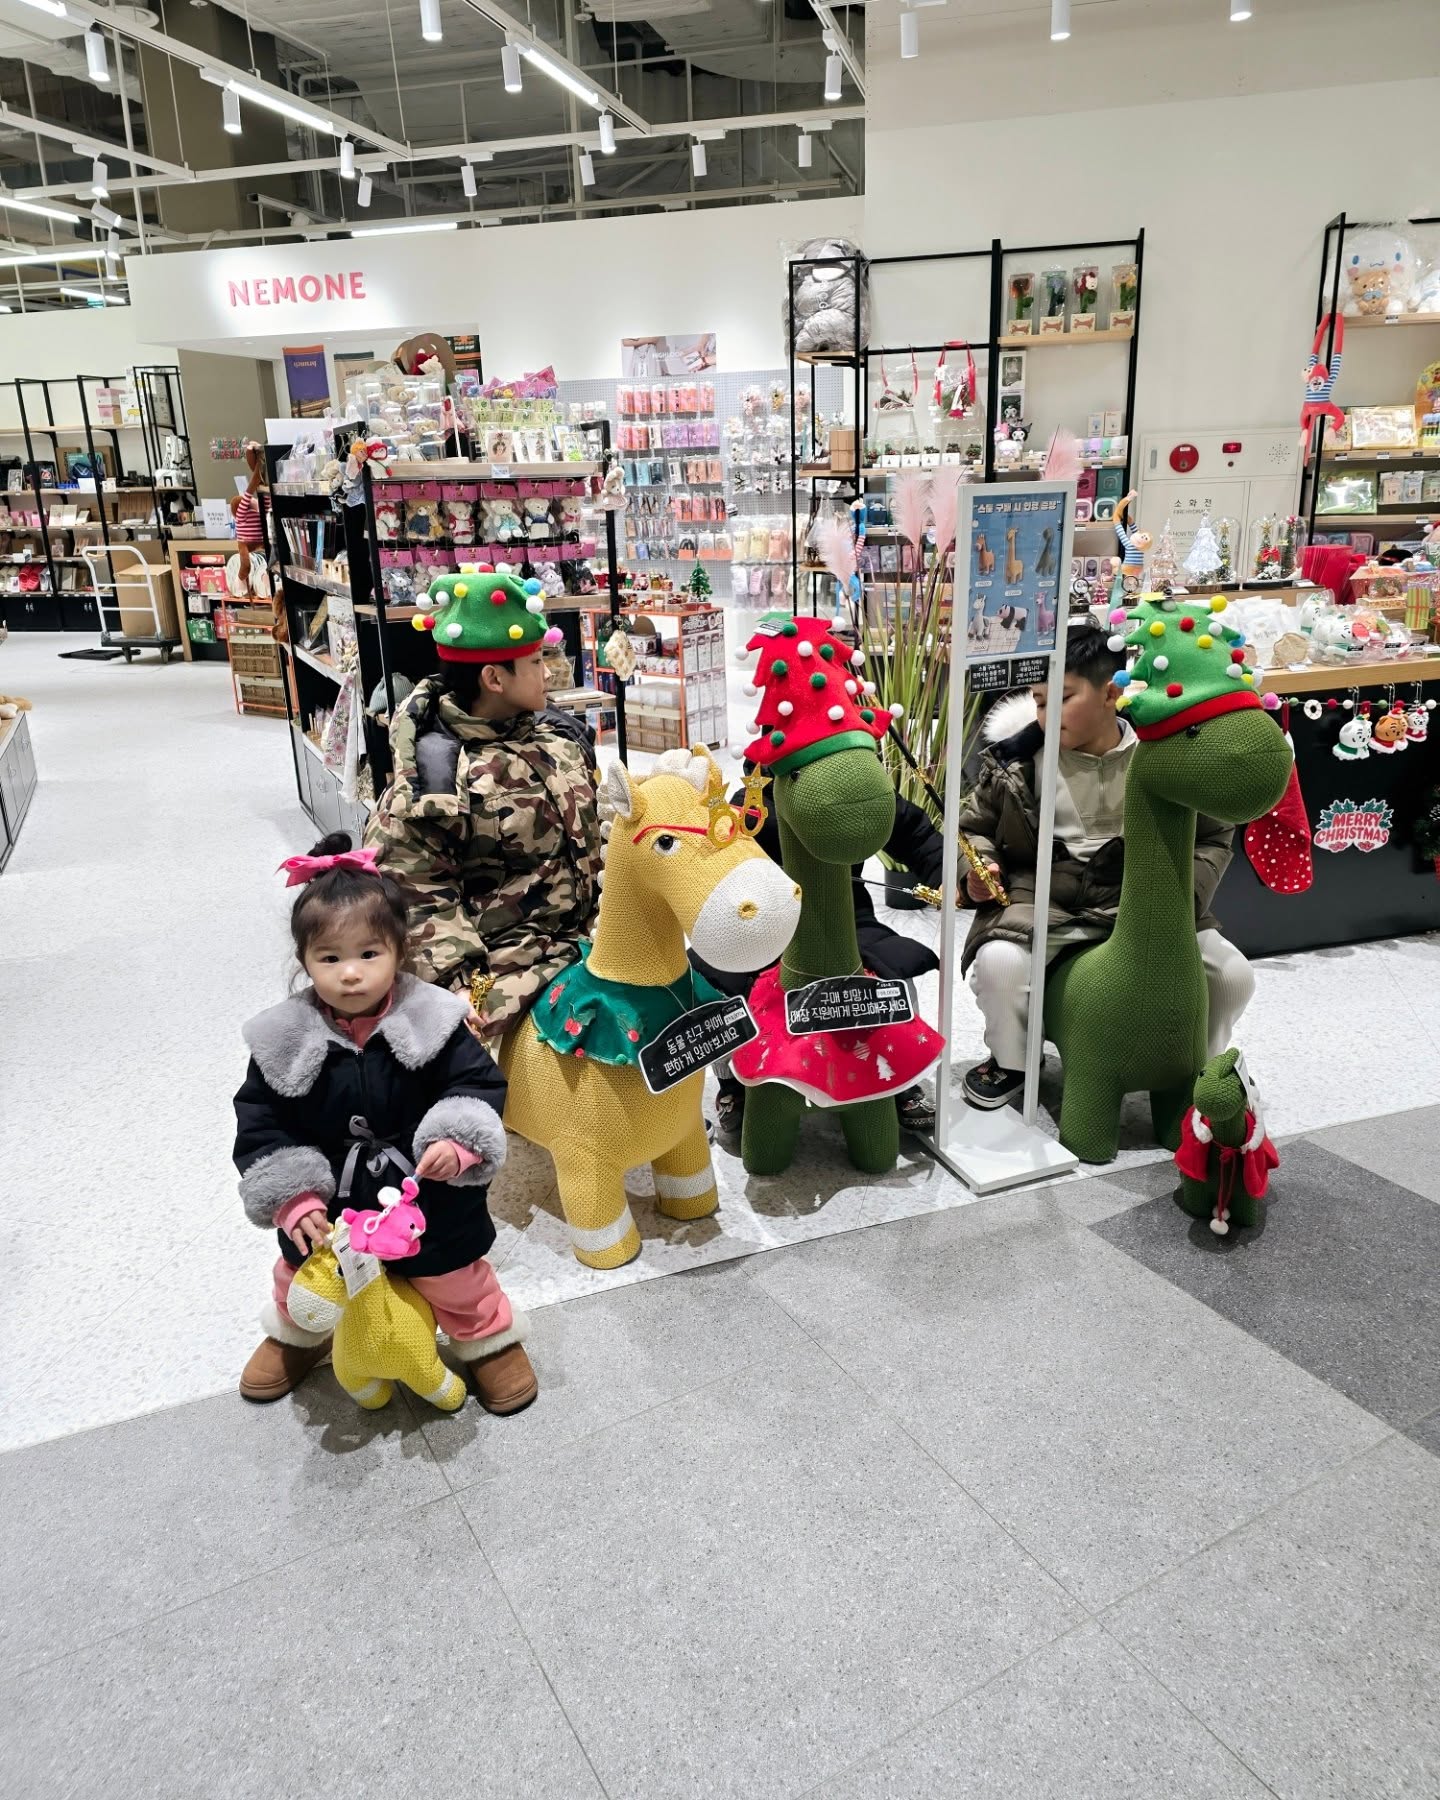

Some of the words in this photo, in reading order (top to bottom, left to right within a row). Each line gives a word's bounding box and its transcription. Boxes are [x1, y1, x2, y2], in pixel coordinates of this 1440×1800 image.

[228, 271, 366, 307] NEMONE
[1332, 812, 1383, 828] MERRY
[1314, 826, 1389, 845] CHRISTMAS
[820, 991, 840, 1005] 구매
[843, 988, 861, 1003] 희망
[790, 1008, 810, 1024] 매장
[811, 1005, 851, 1020] 직원에게
[851, 998, 908, 1018] 문의해주세요
[666, 1034, 686, 1055] 동물
[685, 1024, 705, 1044] 친구
[704, 1013, 724, 1032] 위에
[663, 1050, 695, 1077] 편하게
[693, 1026, 740, 1061] 앉아보세요
